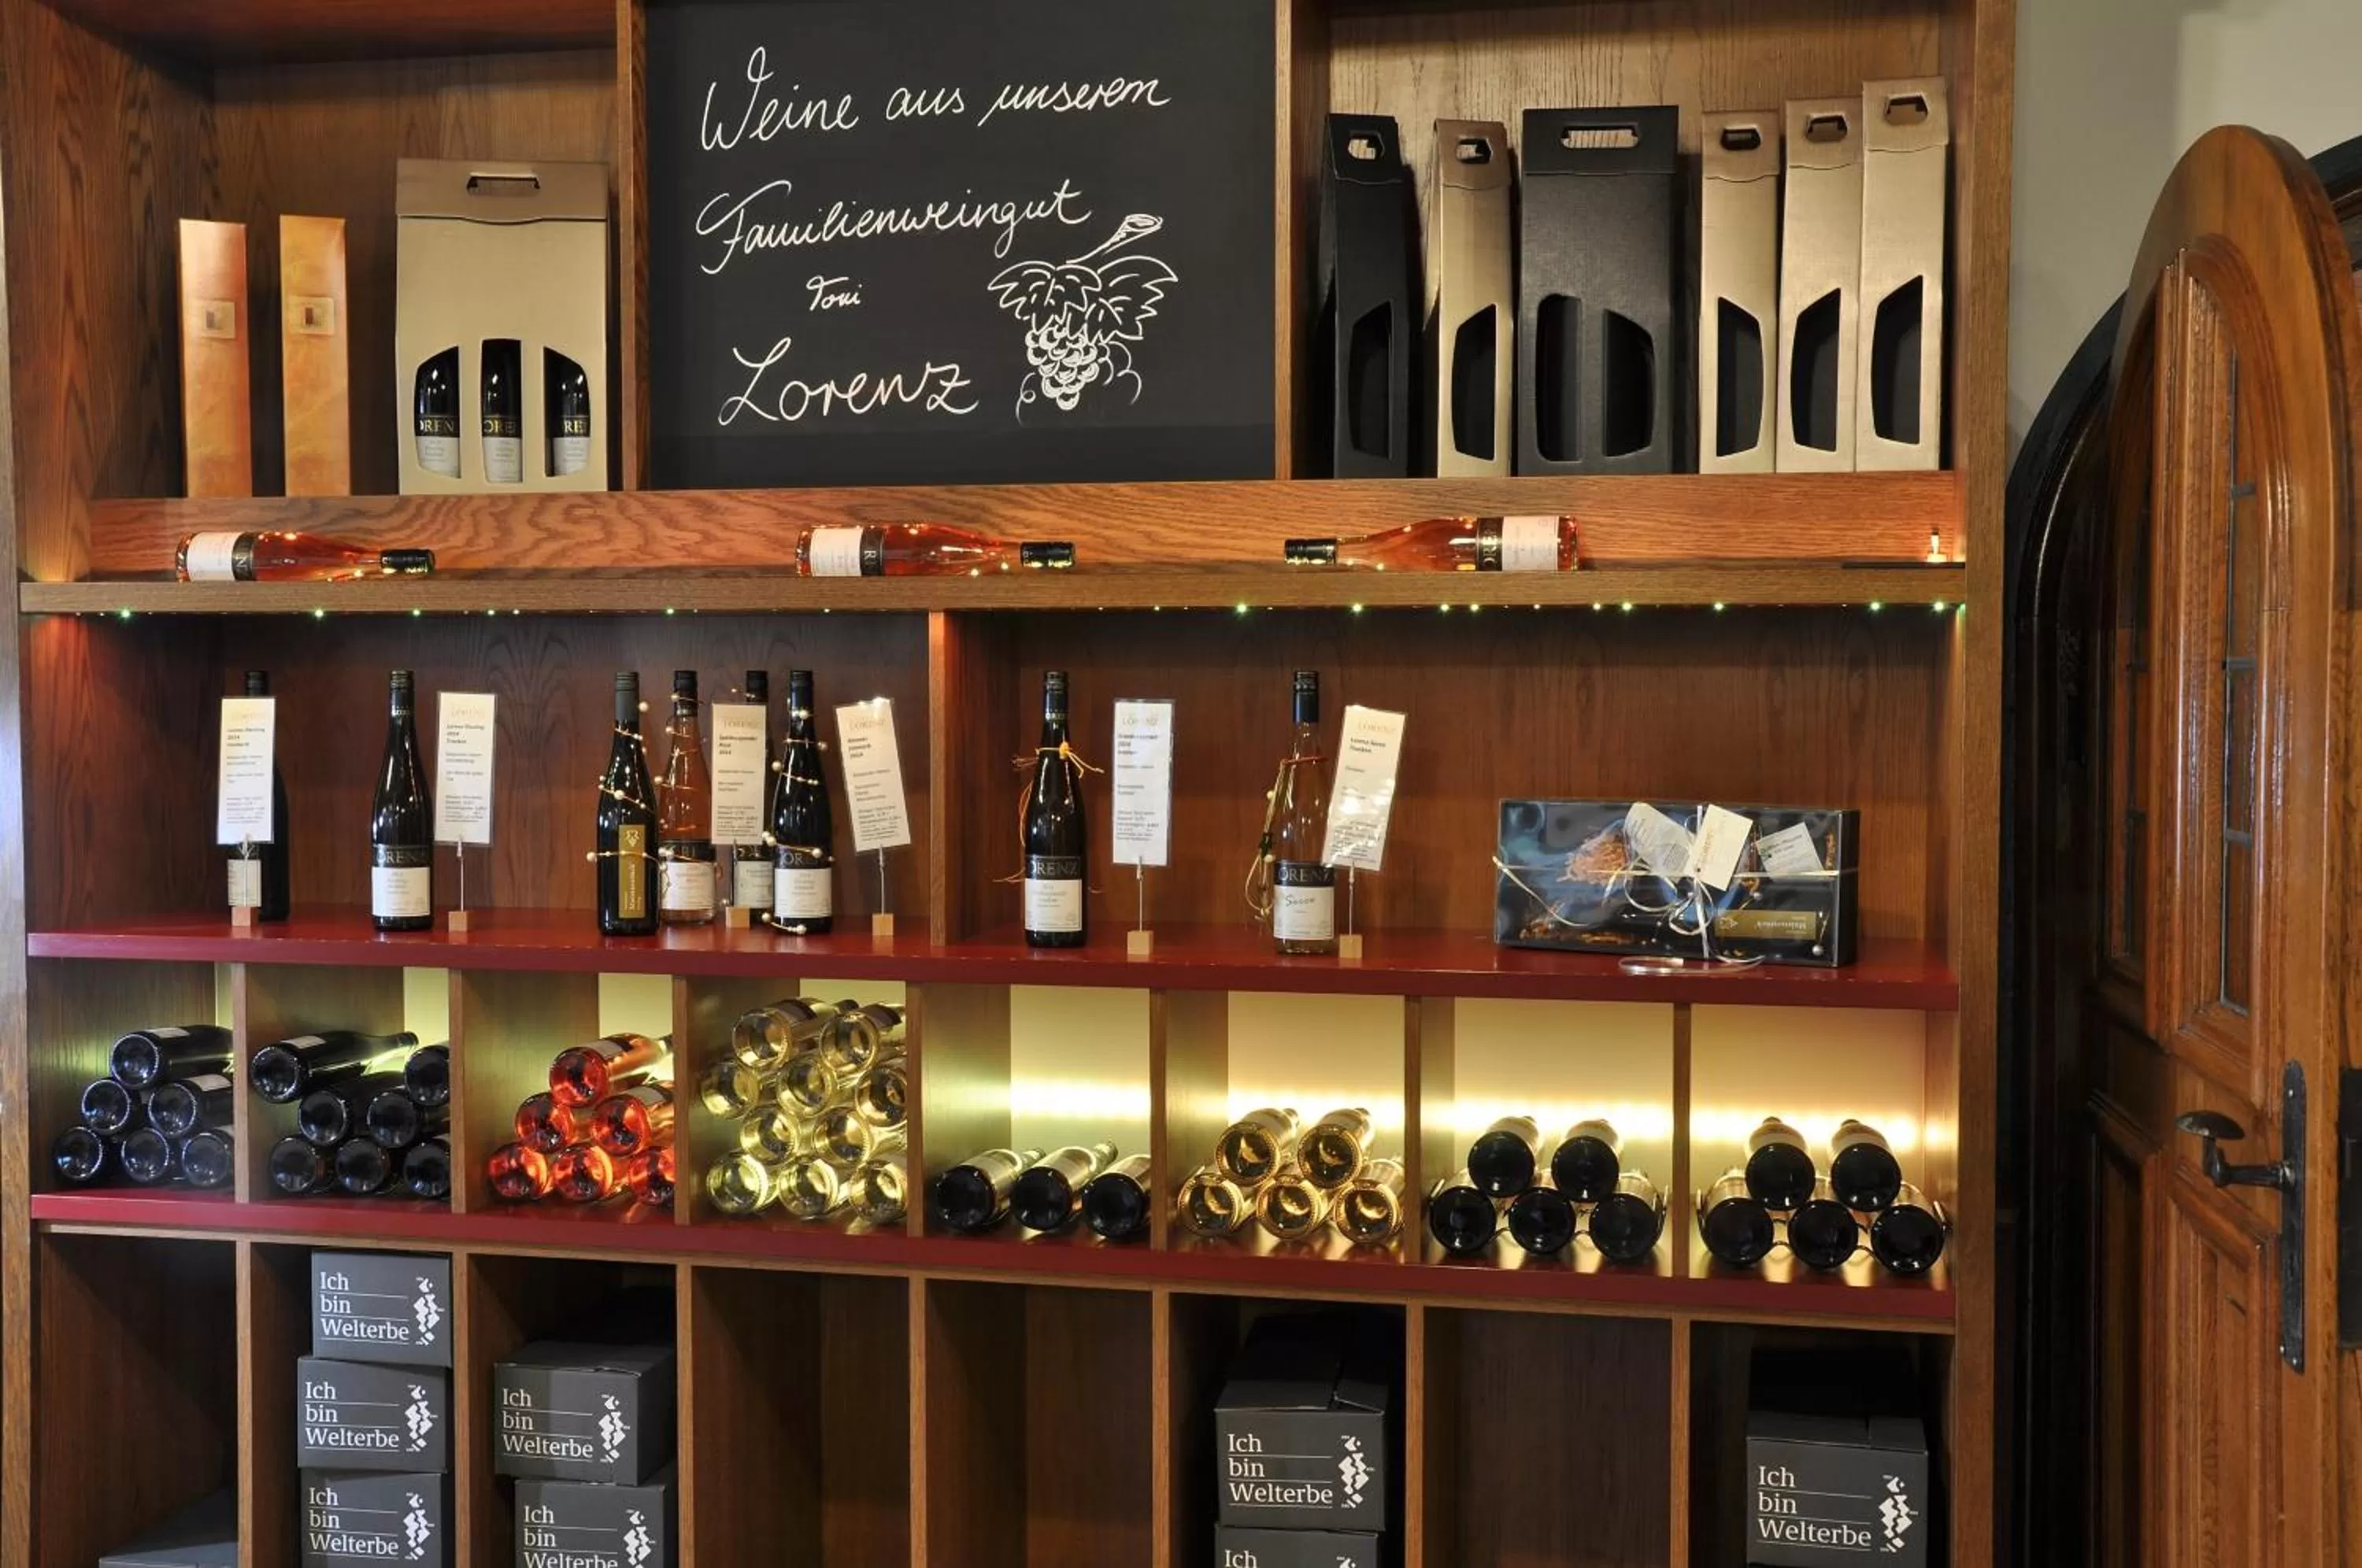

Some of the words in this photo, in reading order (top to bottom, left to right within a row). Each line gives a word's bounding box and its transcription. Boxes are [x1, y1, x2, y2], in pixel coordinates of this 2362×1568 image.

[701, 46, 859, 150] Weine
[886, 86, 965, 120] aus
[977, 76, 1172, 127] unserem
[695, 179, 1091, 275] Familienweingut
[717, 336, 979, 427] Lorenz
[320, 1271, 350, 1292] Ich
[320, 1293, 351, 1314] bin
[320, 1318, 409, 1341] Welterbe
[305, 1381, 337, 1400] Ich
[502, 1388, 532, 1407] Ich
[305, 1403, 339, 1423] bin
[502, 1410, 534, 1430] bin
[305, 1427, 400, 1448] Welterbe
[502, 1433, 594, 1458] Welterbe
[1227, 1433, 1263, 1453] Ich
[1227, 1457, 1265, 1477] bin
[1758, 1465, 1797, 1488] Ich
[309, 1487, 339, 1506] Ich
[1228, 1482, 1334, 1504] Welterbe
[1758, 1492, 1797, 1514] bin
[309, 1509, 341, 1529] bin
[524, 1505, 555, 1525] Ich
[524, 1528, 557, 1548] bin
[1757, 1518, 1872, 1547] Welterbe
[309, 1533, 399, 1555] Welterbe
[524, 1551, 619, 1568] Welterbe
[1224, 1549, 1258, 1568] Ich
